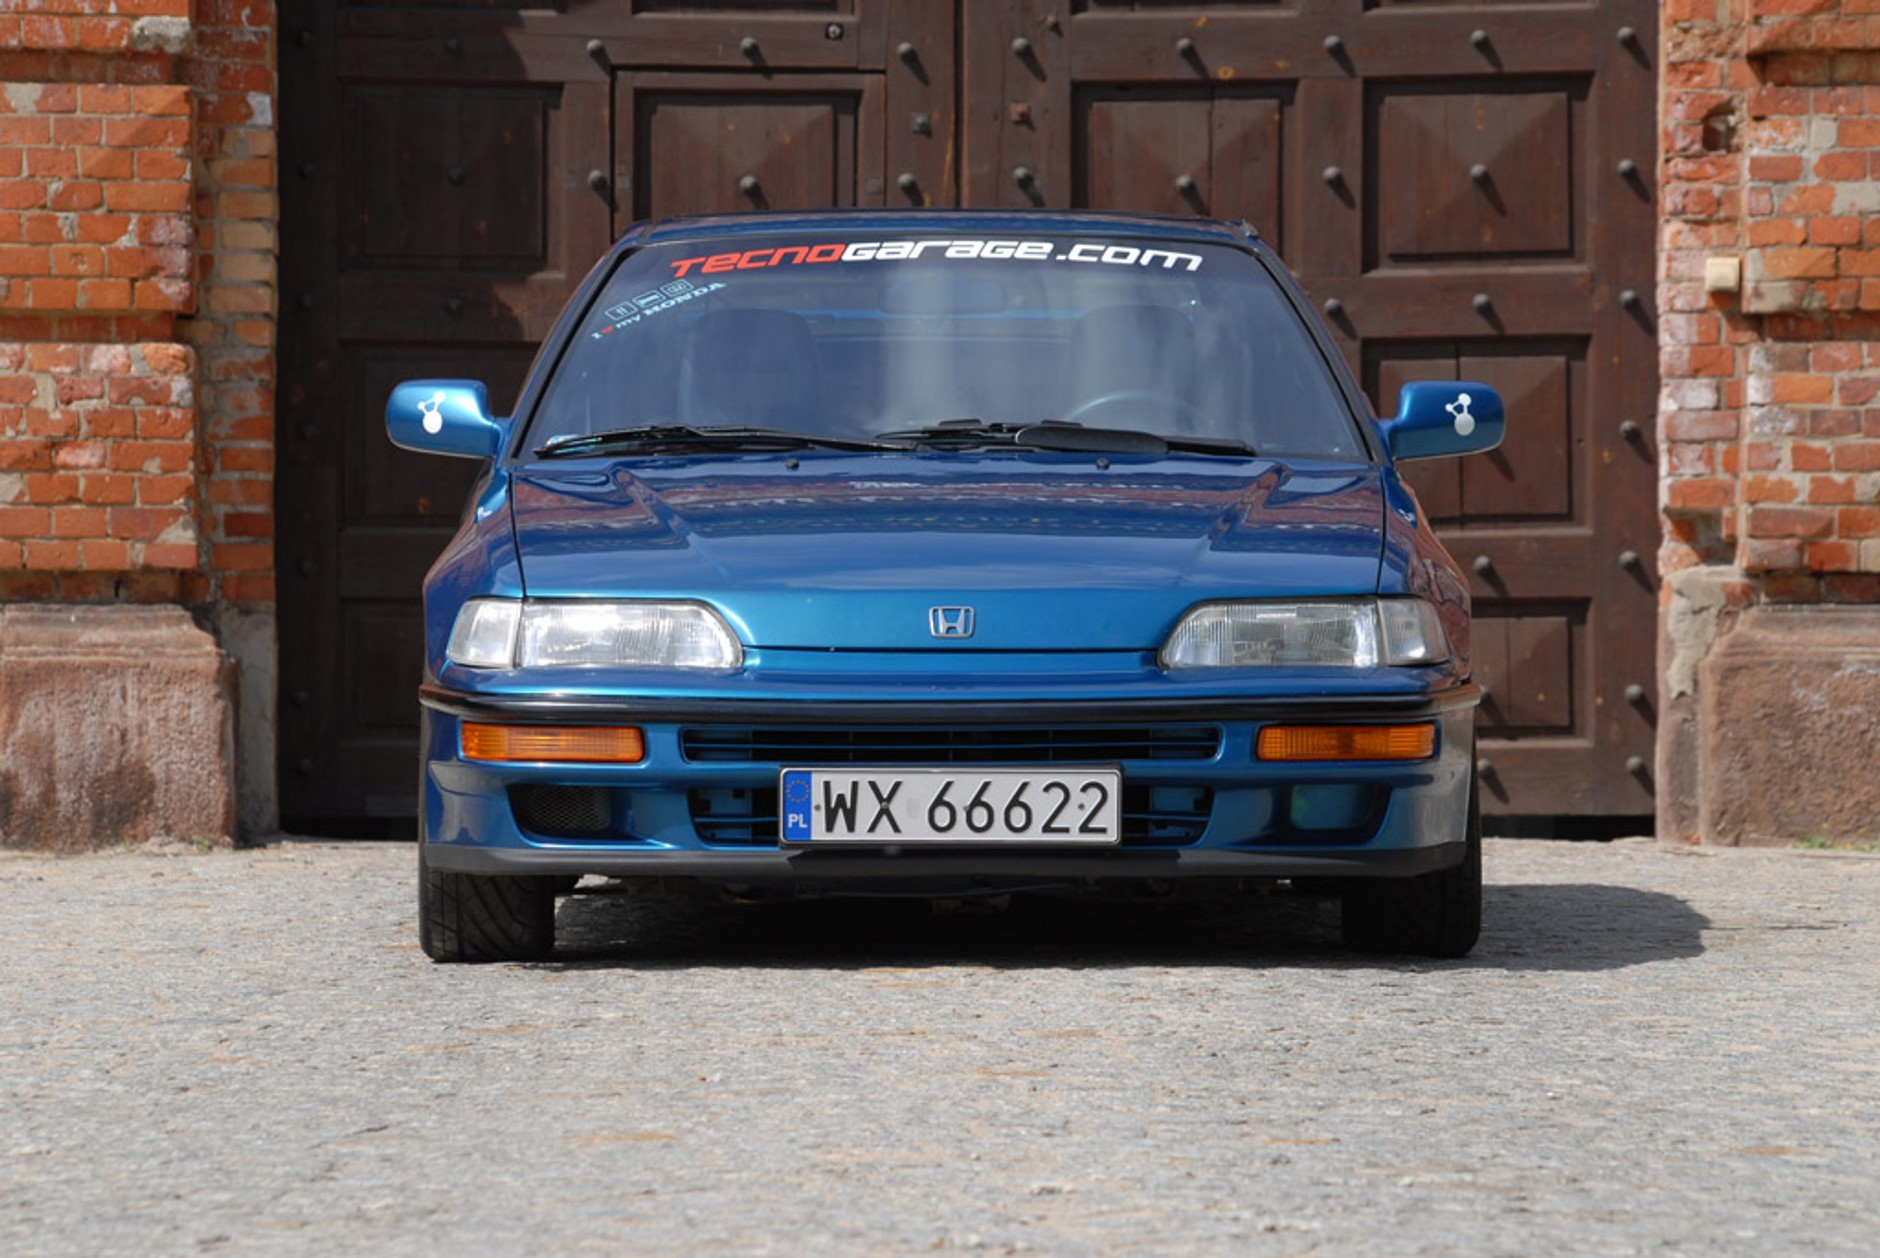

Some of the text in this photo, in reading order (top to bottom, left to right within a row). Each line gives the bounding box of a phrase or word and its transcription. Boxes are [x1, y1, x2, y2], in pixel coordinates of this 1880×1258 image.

[642, 282, 727, 316] HONDA
[788, 814, 808, 828] PL
[823, 780, 1108, 833] WX 66622
